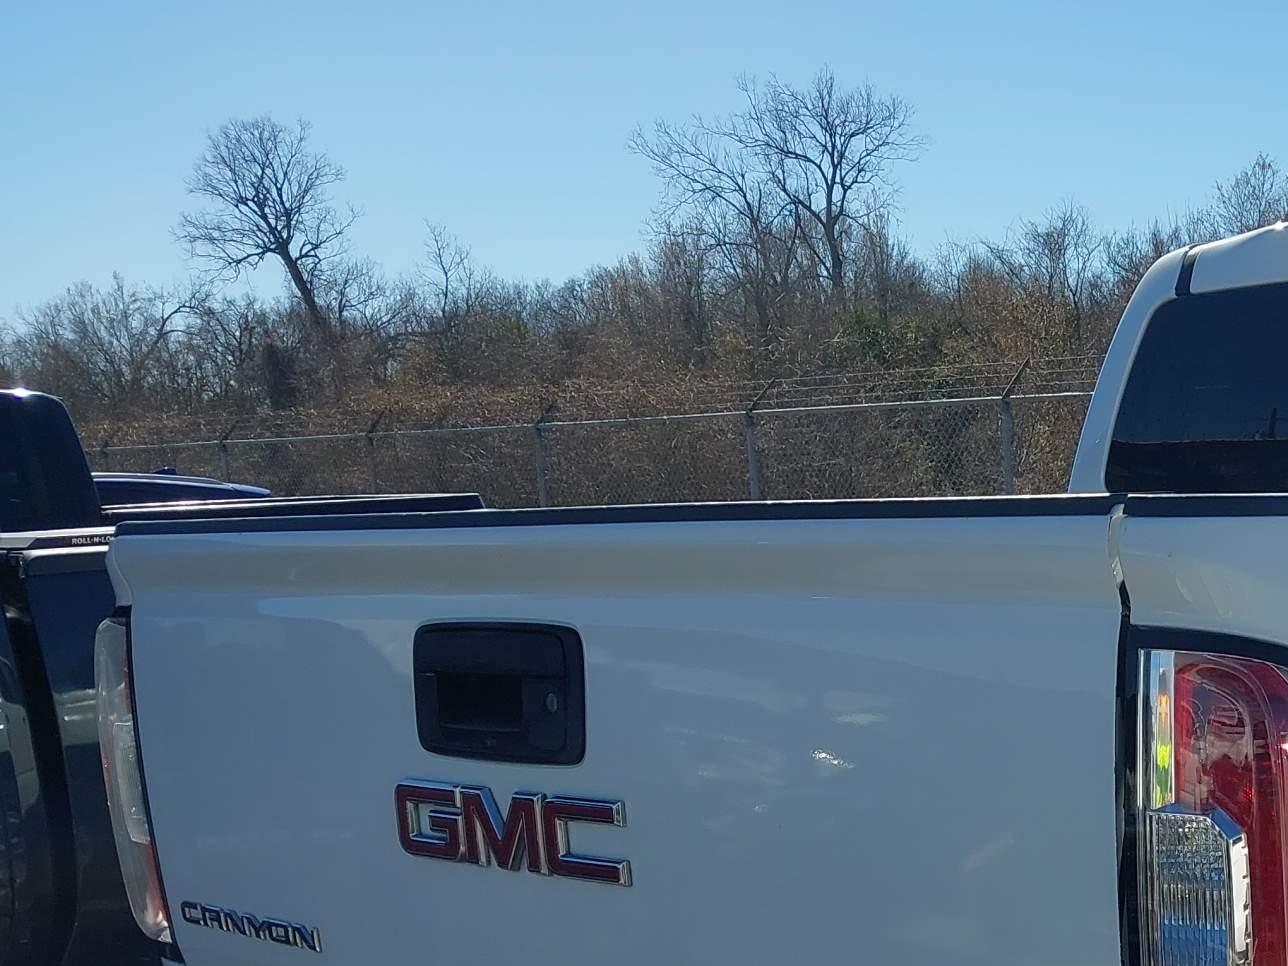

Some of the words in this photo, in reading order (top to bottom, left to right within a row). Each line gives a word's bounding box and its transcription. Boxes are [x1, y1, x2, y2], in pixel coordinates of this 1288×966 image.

[71, 535, 115, 545] ROLL-N-LO
[394, 777, 633, 888] GMC
[181, 900, 322, 953] CANYON
